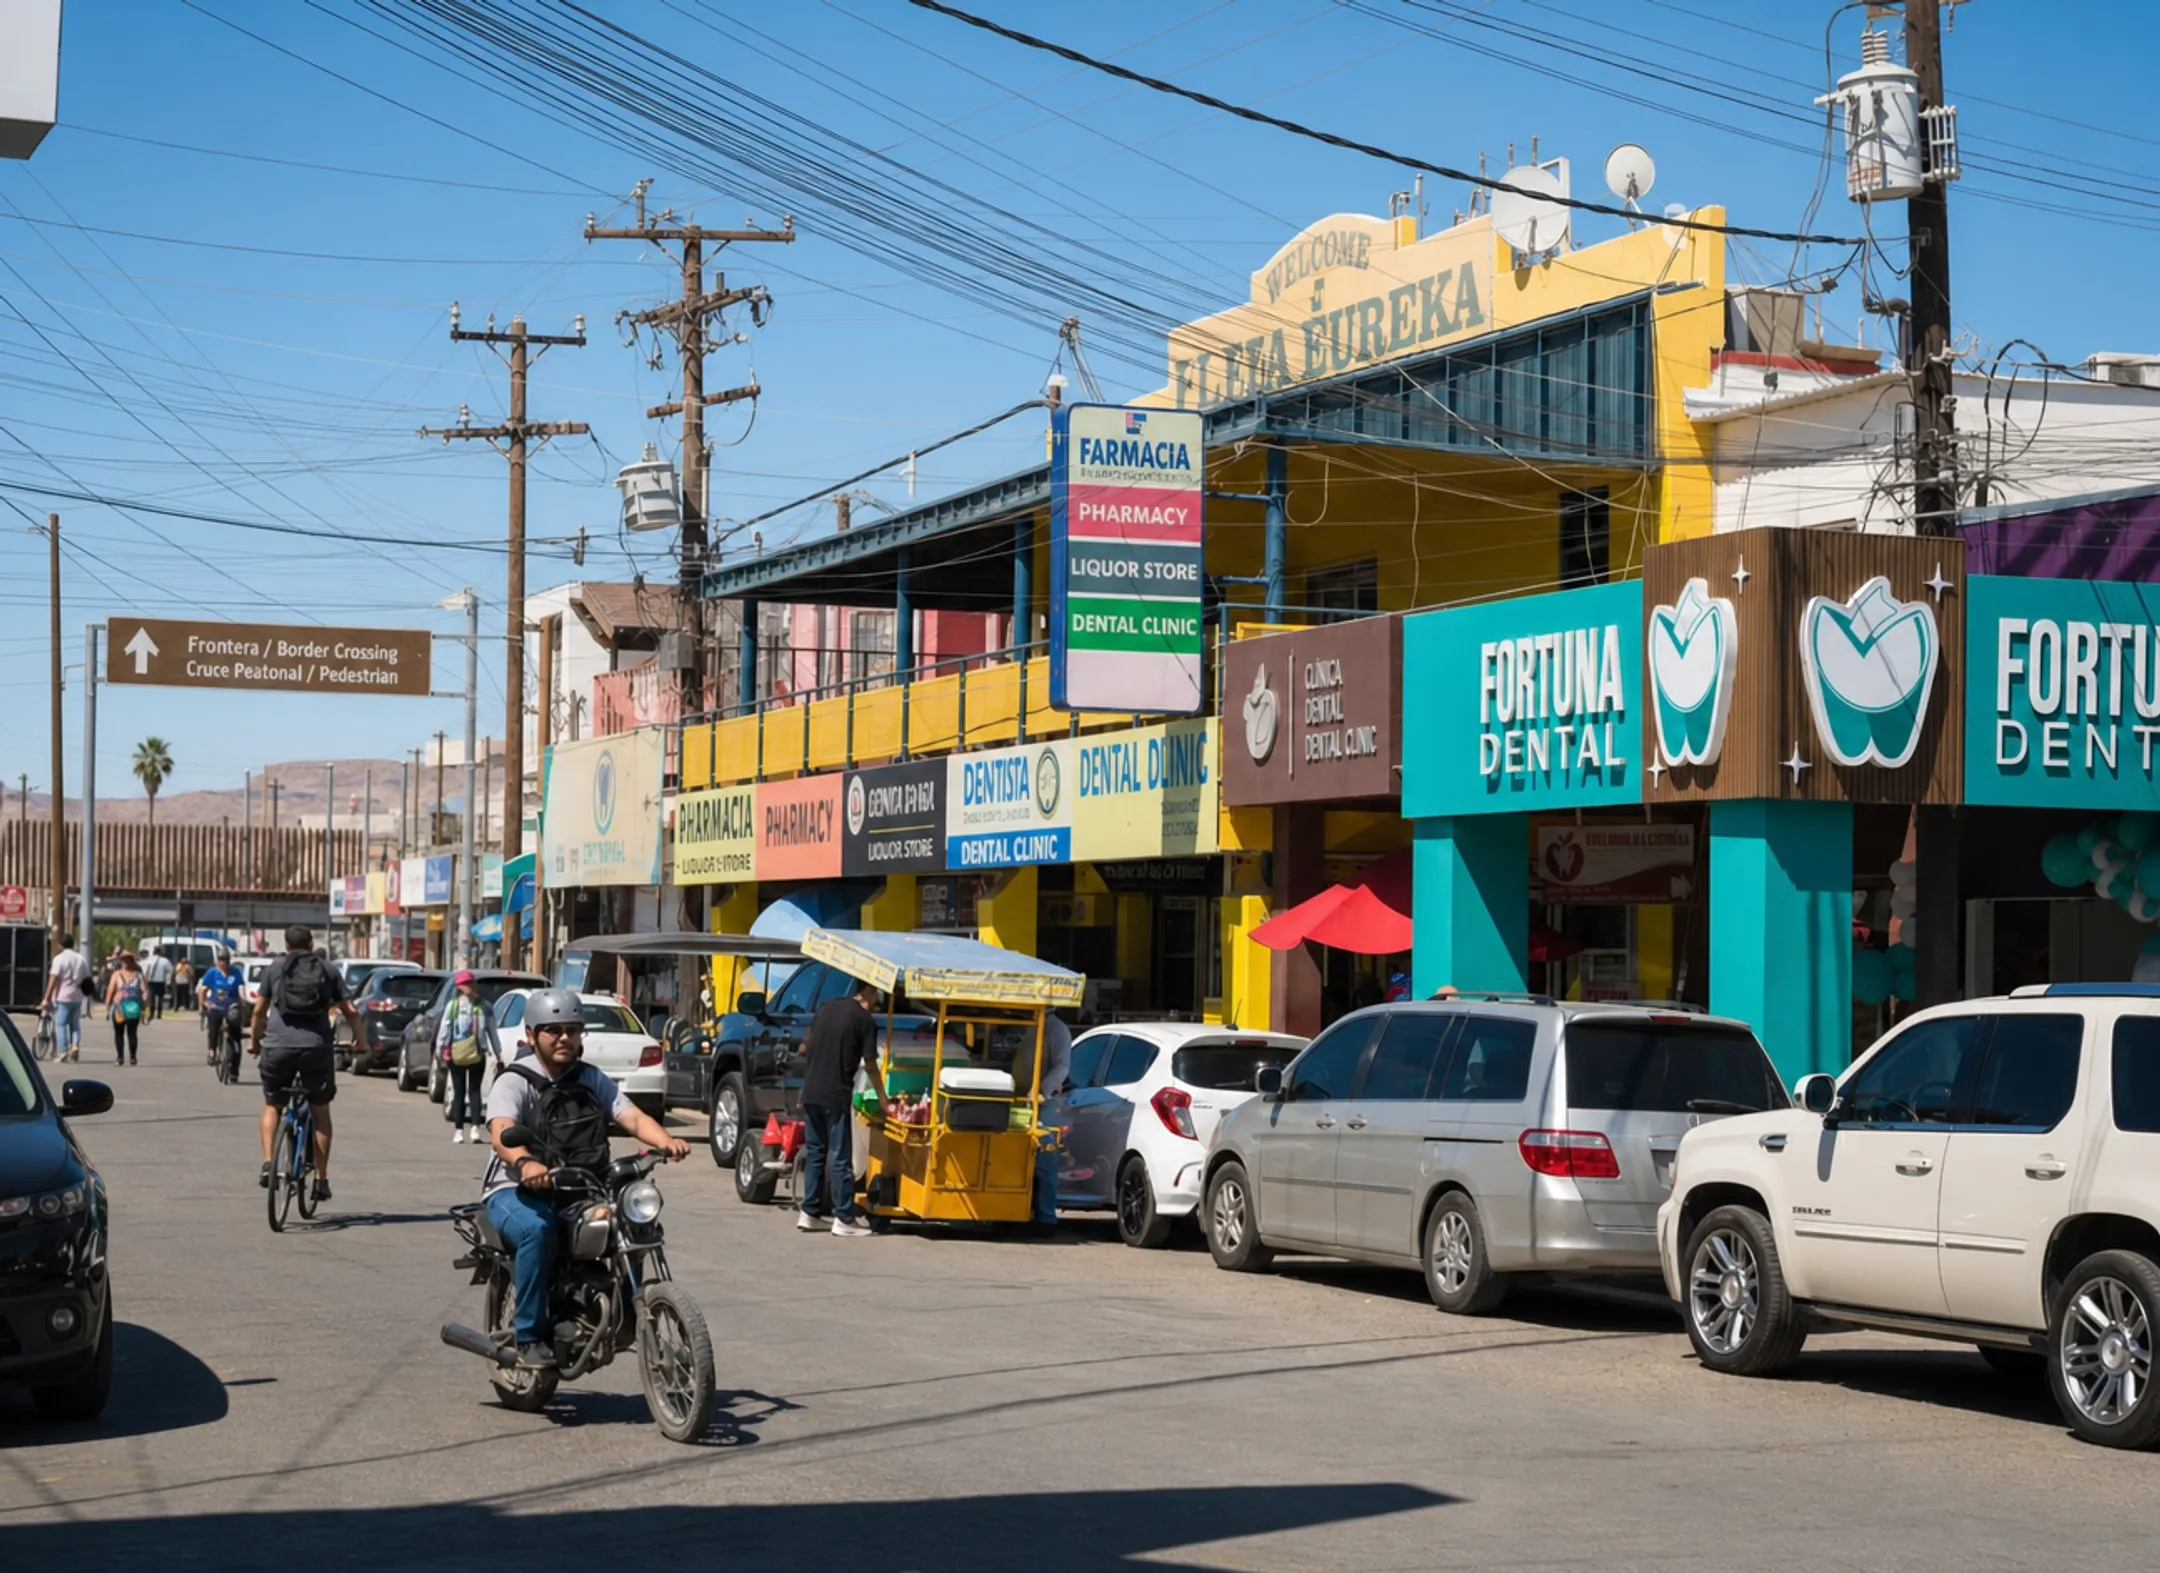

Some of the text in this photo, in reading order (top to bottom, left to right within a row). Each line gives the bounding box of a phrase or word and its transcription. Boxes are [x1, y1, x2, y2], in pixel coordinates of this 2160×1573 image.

[1265, 231, 1372, 304] WELCOME
[1301, 260, 1485, 379] EUREKA
[1080, 438, 1191, 470] FARMACIA
[1079, 502, 1188, 526] PHARMACY
[1071, 558, 1198, 580] LIQUOR STORE
[1072, 613, 1197, 635] DENTAL CLINIC
[186, 660, 230, 678] Cruce
[235, 662, 302, 681] Peatonal
[320, 665, 399, 684] Pedestrian
[188, 636, 260, 656] Frontera
[277, 640, 330, 658] Border
[334, 643, 398, 665] Crossing
[1480, 625, 1625, 724] FORTUNA
[1480, 722, 1626, 775] DENTAL
[1996, 718, 2160, 770] DENT
[963, 756, 1030, 806] DENTISTA
[1080, 741, 1141, 798] DENTAL
[680, 794, 753, 844] PHARMACIA
[766, 799, 834, 847] PHARMACY
[961, 835, 1058, 865] DENTAL CLINIC
